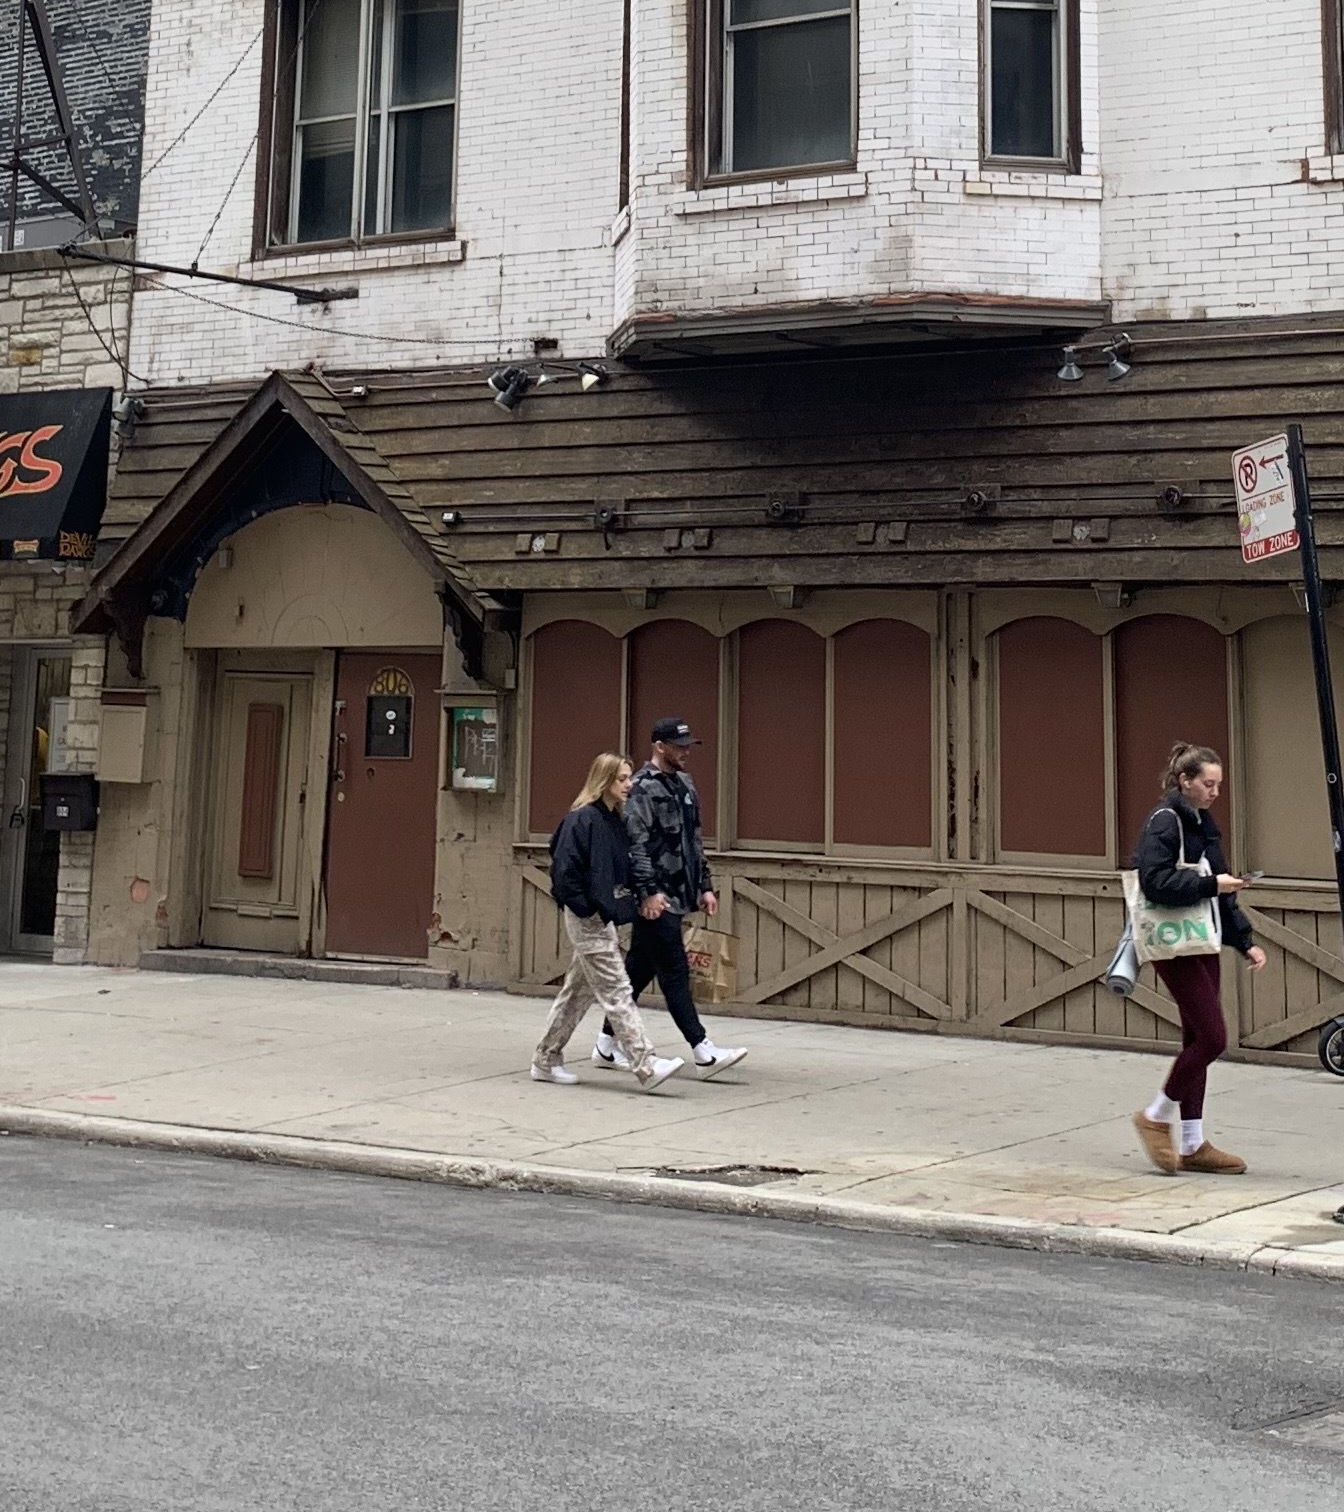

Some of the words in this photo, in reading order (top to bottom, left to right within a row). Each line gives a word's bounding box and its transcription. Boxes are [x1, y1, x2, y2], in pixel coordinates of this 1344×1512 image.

[1241, 497, 1267, 513] LOADING
[1269, 491, 1285, 506] ZONE
[1246, 541, 1265, 558] TOW
[1269, 533, 1294, 551] ZONE
